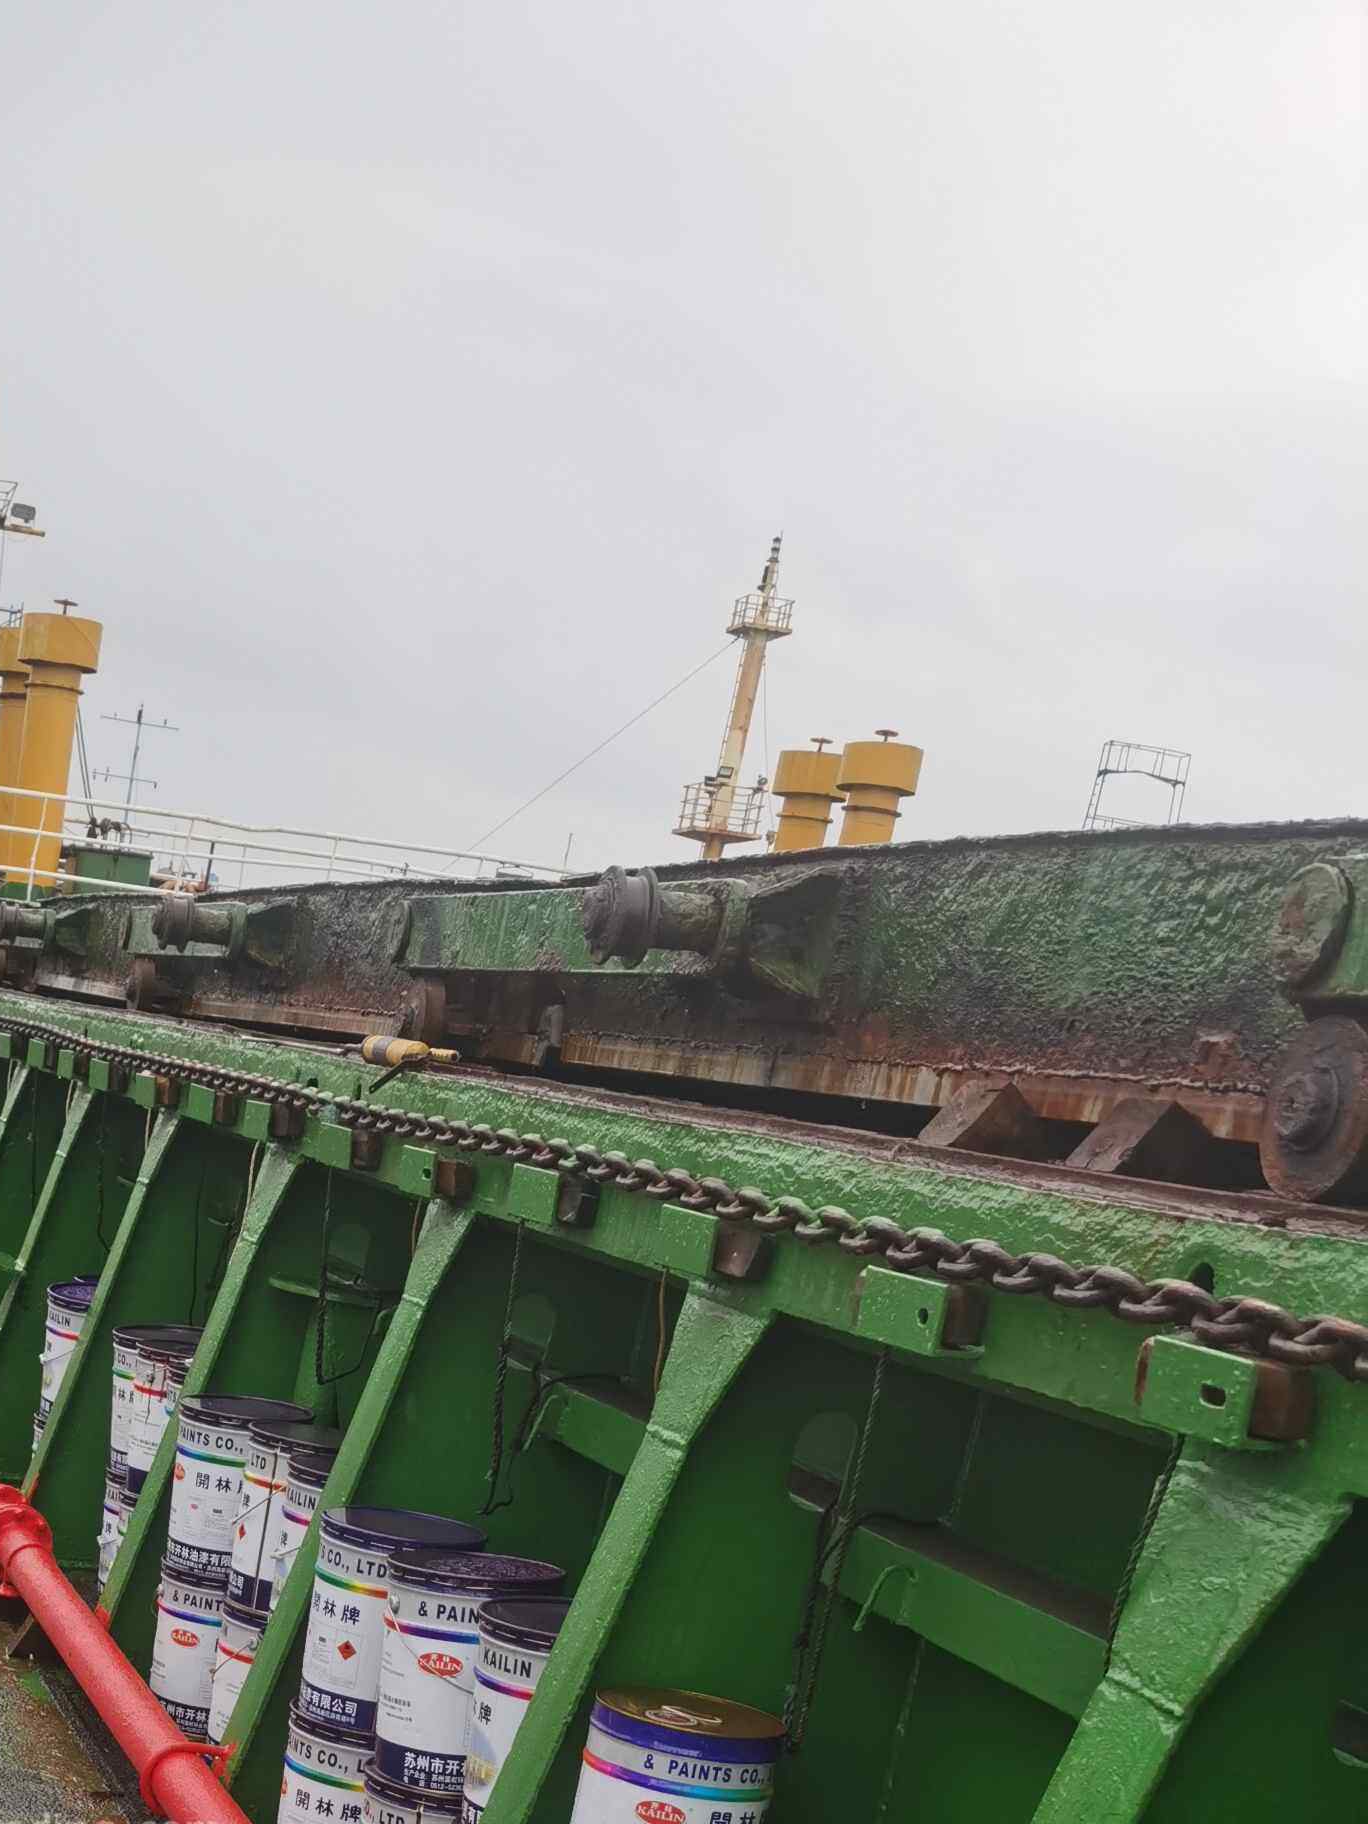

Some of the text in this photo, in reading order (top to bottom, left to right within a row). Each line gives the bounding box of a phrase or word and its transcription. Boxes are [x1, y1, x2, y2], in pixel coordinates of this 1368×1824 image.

[250, 1454, 267, 1470] LTD
[356, 1561, 388, 1579] LTD
[418, 1600, 428, 1616] &
[483, 1646, 532, 1678] KAILIN
[643, 1753, 654, 1770] &
[668, 1759, 733, 1784] PAINTS
[636, 1803, 686, 1823] KAILIN
